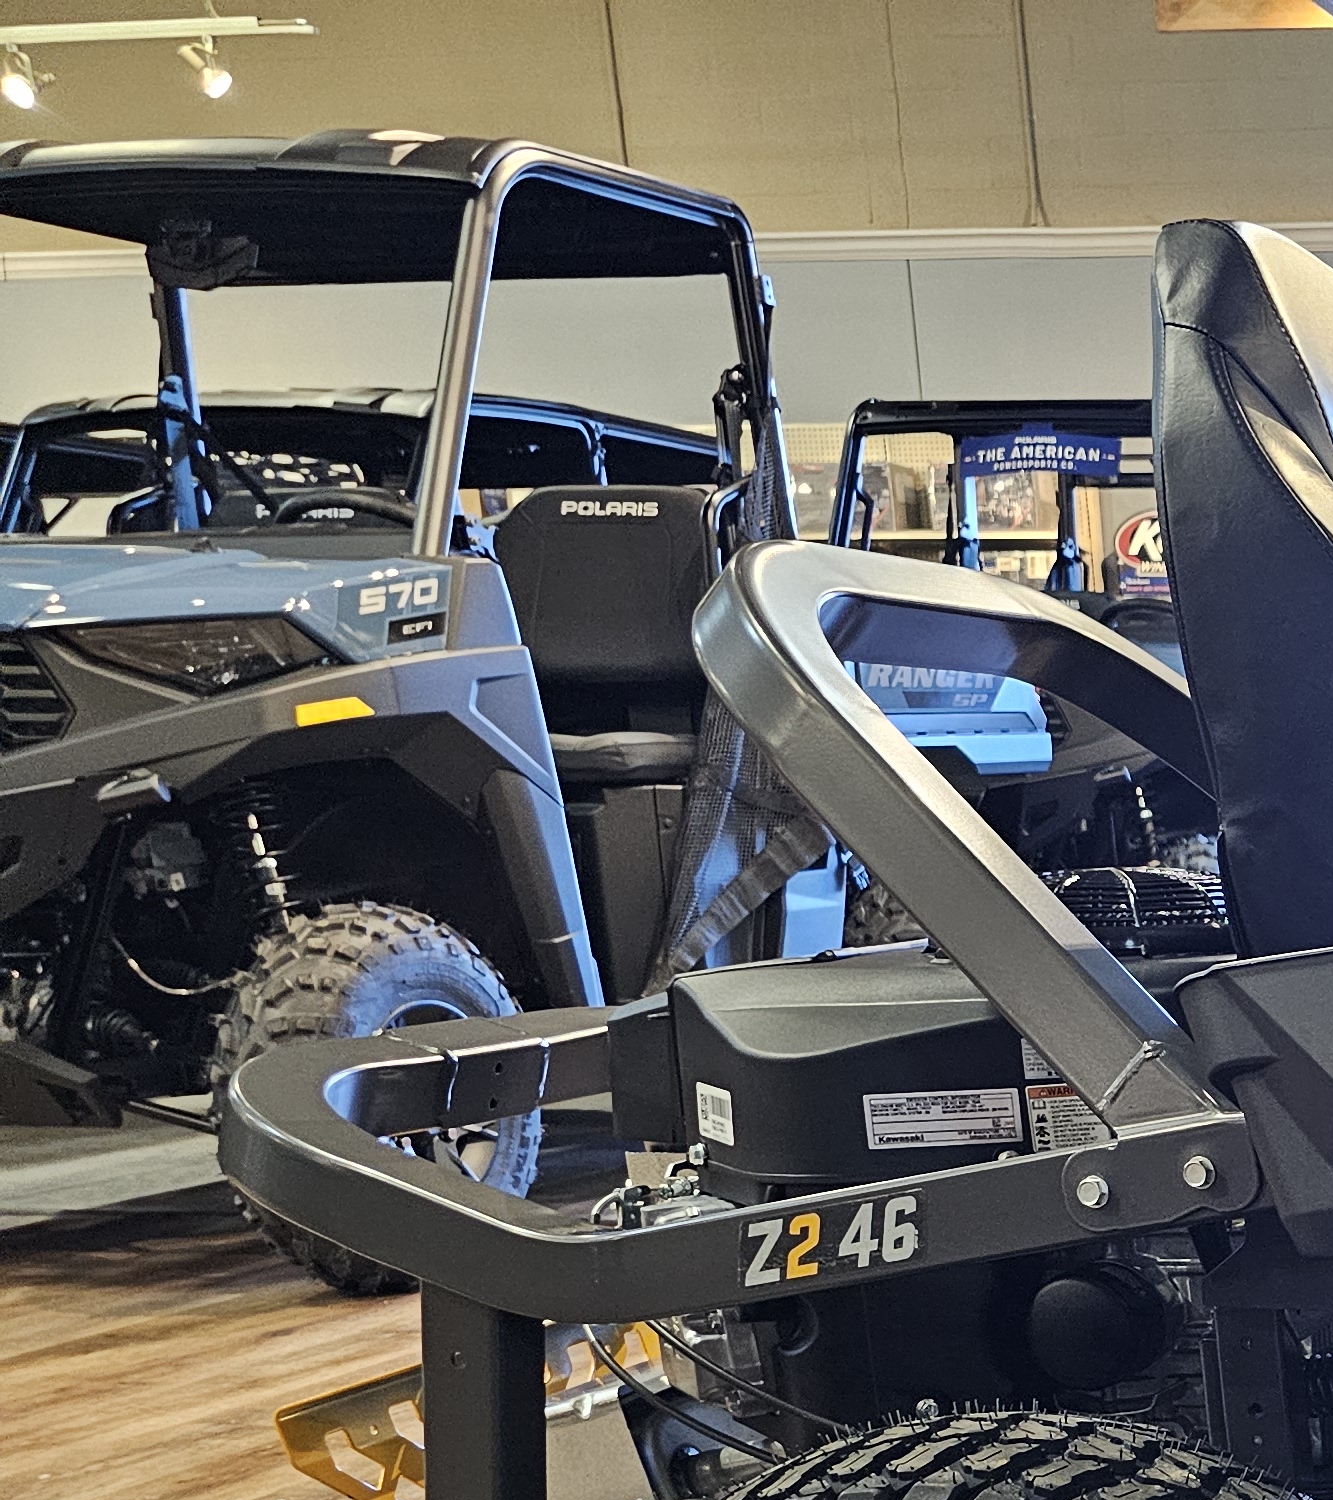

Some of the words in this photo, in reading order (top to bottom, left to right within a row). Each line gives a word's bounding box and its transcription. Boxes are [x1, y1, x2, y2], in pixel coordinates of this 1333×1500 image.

[977, 447, 1005, 463] THE
[1010, 446, 1100, 462] AMERICAN
[560, 501, 659, 517] POLARIS
[359, 578, 438, 615] 570
[868, 664, 995, 689] RANGER
[878, 1134, 925, 1144] Kawasaki
[745, 1212, 821, 1287] Z2
[838, 1196, 918, 1268] 46
